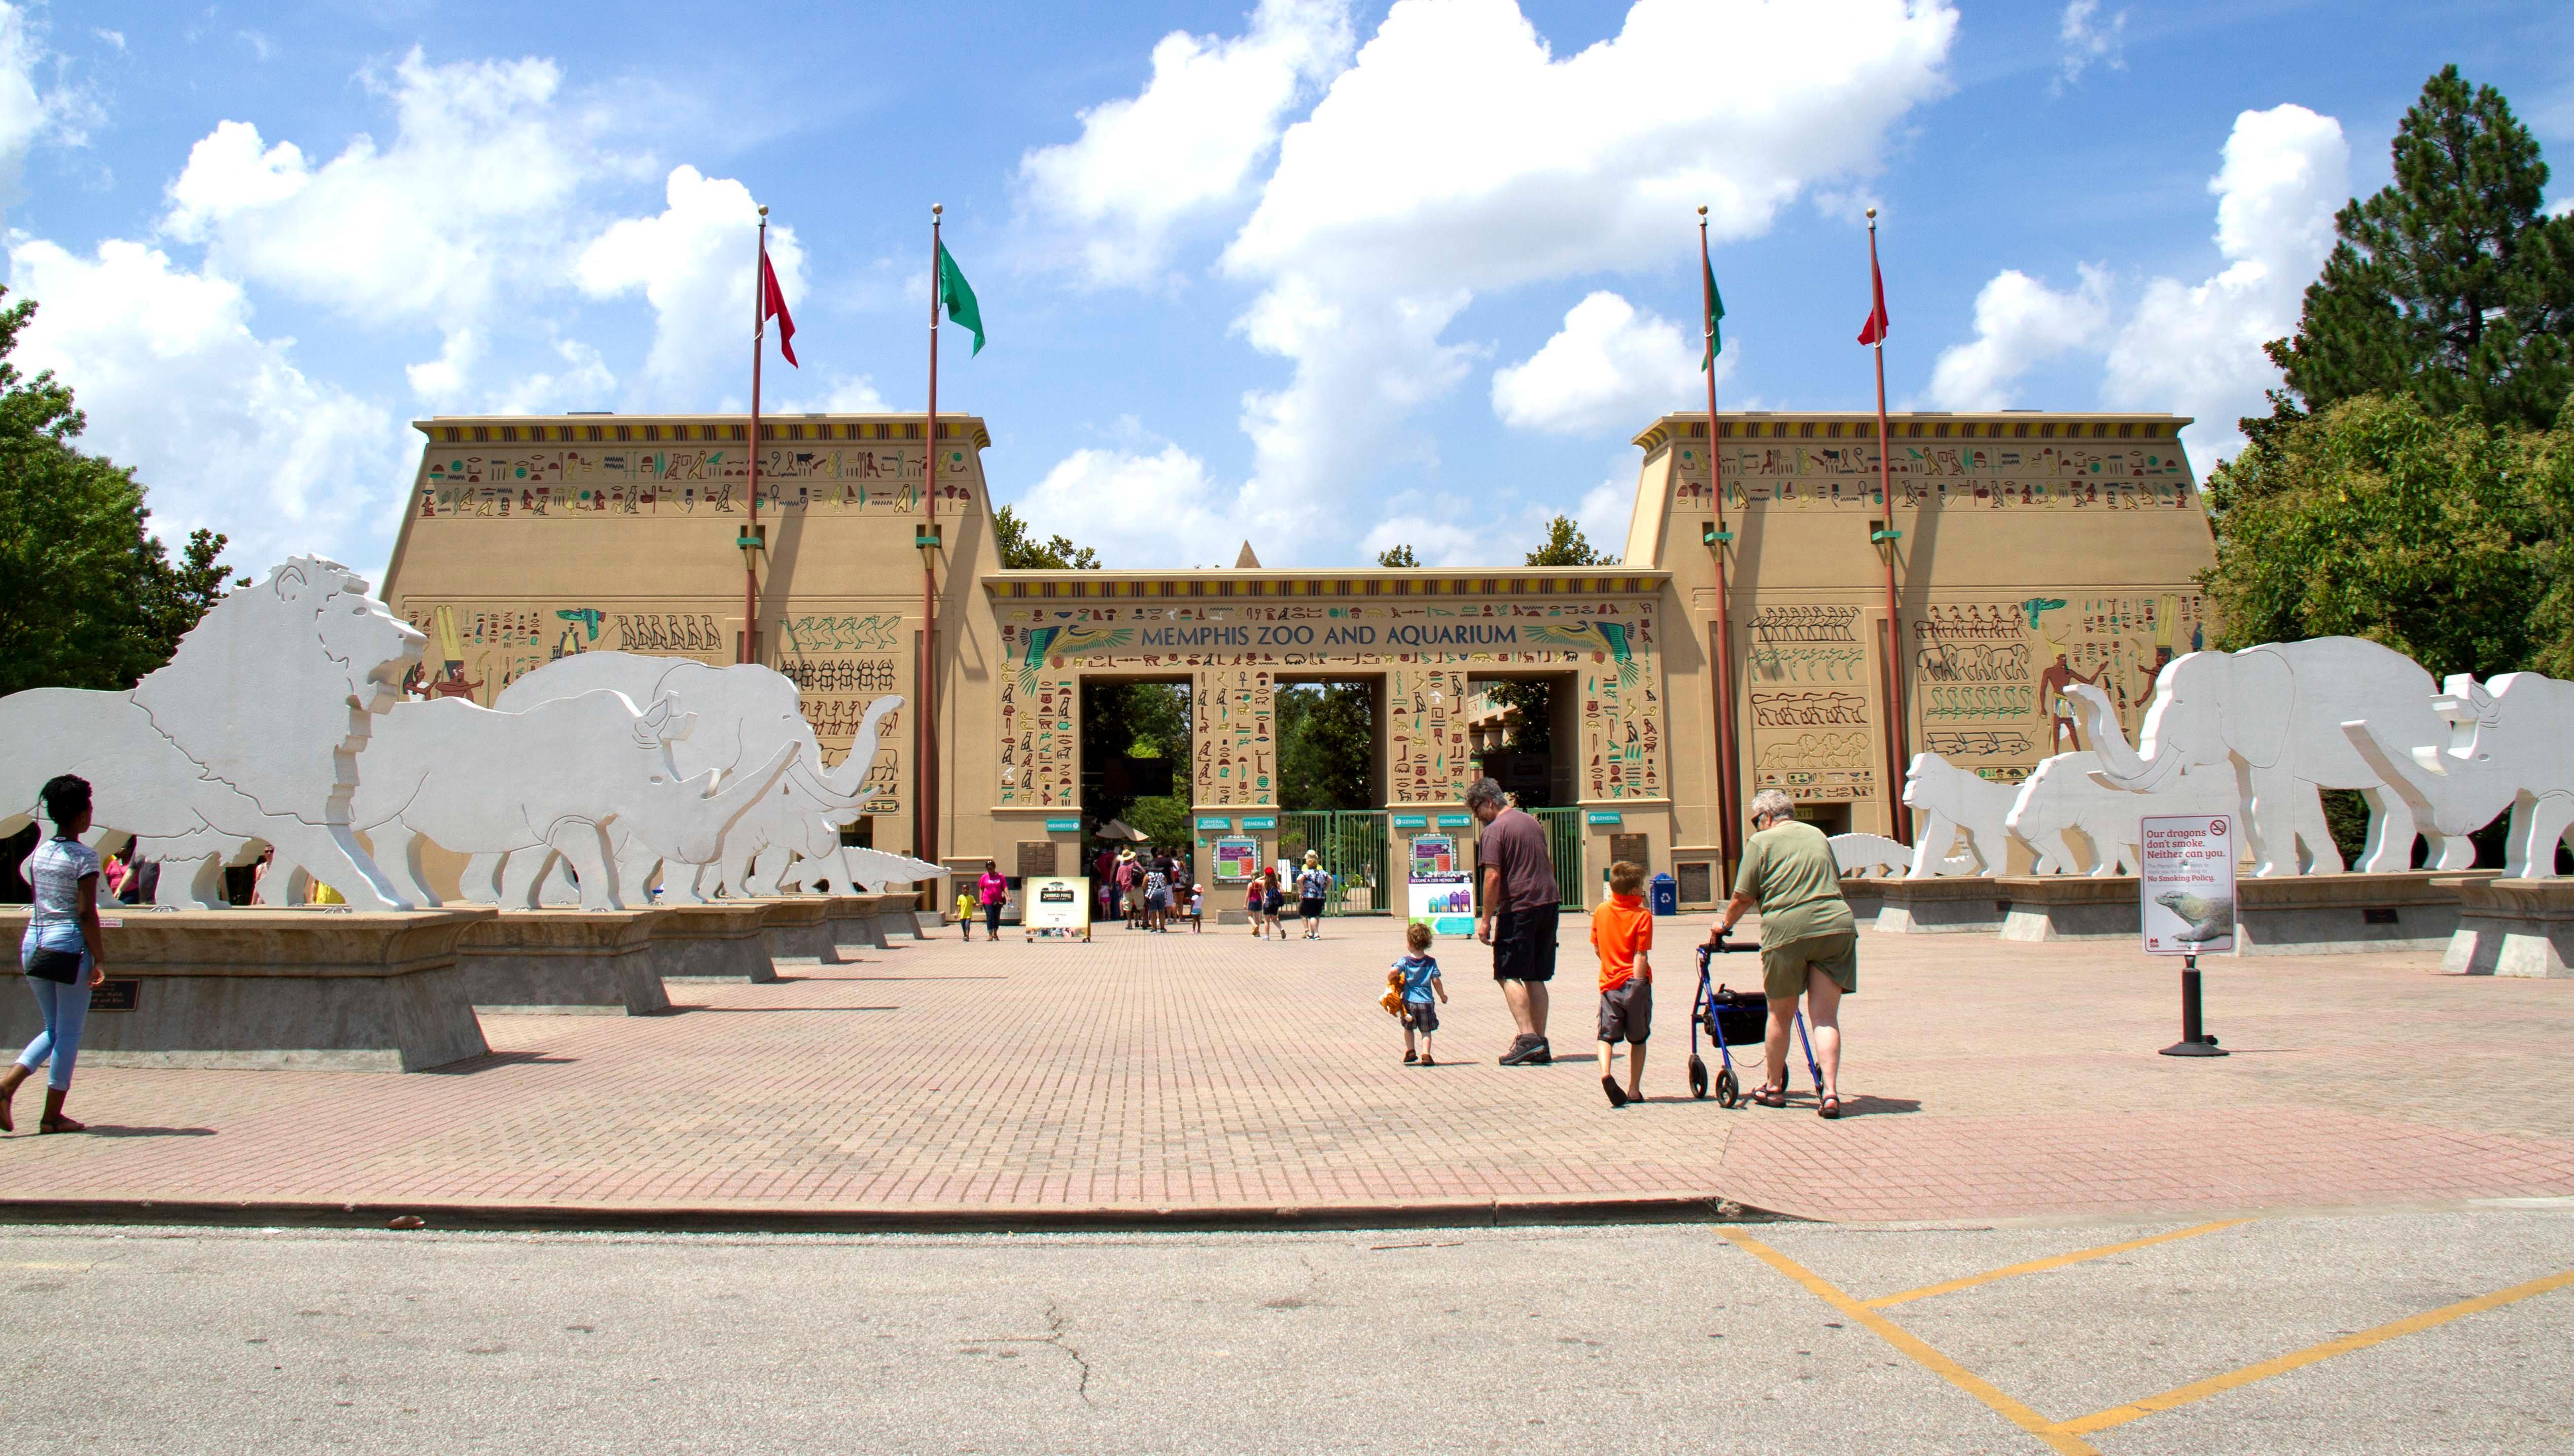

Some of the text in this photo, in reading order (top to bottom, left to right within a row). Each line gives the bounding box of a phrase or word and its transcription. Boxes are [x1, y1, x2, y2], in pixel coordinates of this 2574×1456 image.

[1142, 625, 1517, 646] MEMPHIS ZOO AND AQUARIUM
[2167, 829, 2206, 839] dragons
[2146, 839, 2205, 848] don't smoke.
[2147, 849, 2183, 859] Neither
[2205, 850, 2226, 859] you.
[2159, 875, 2190, 883] Smoking
